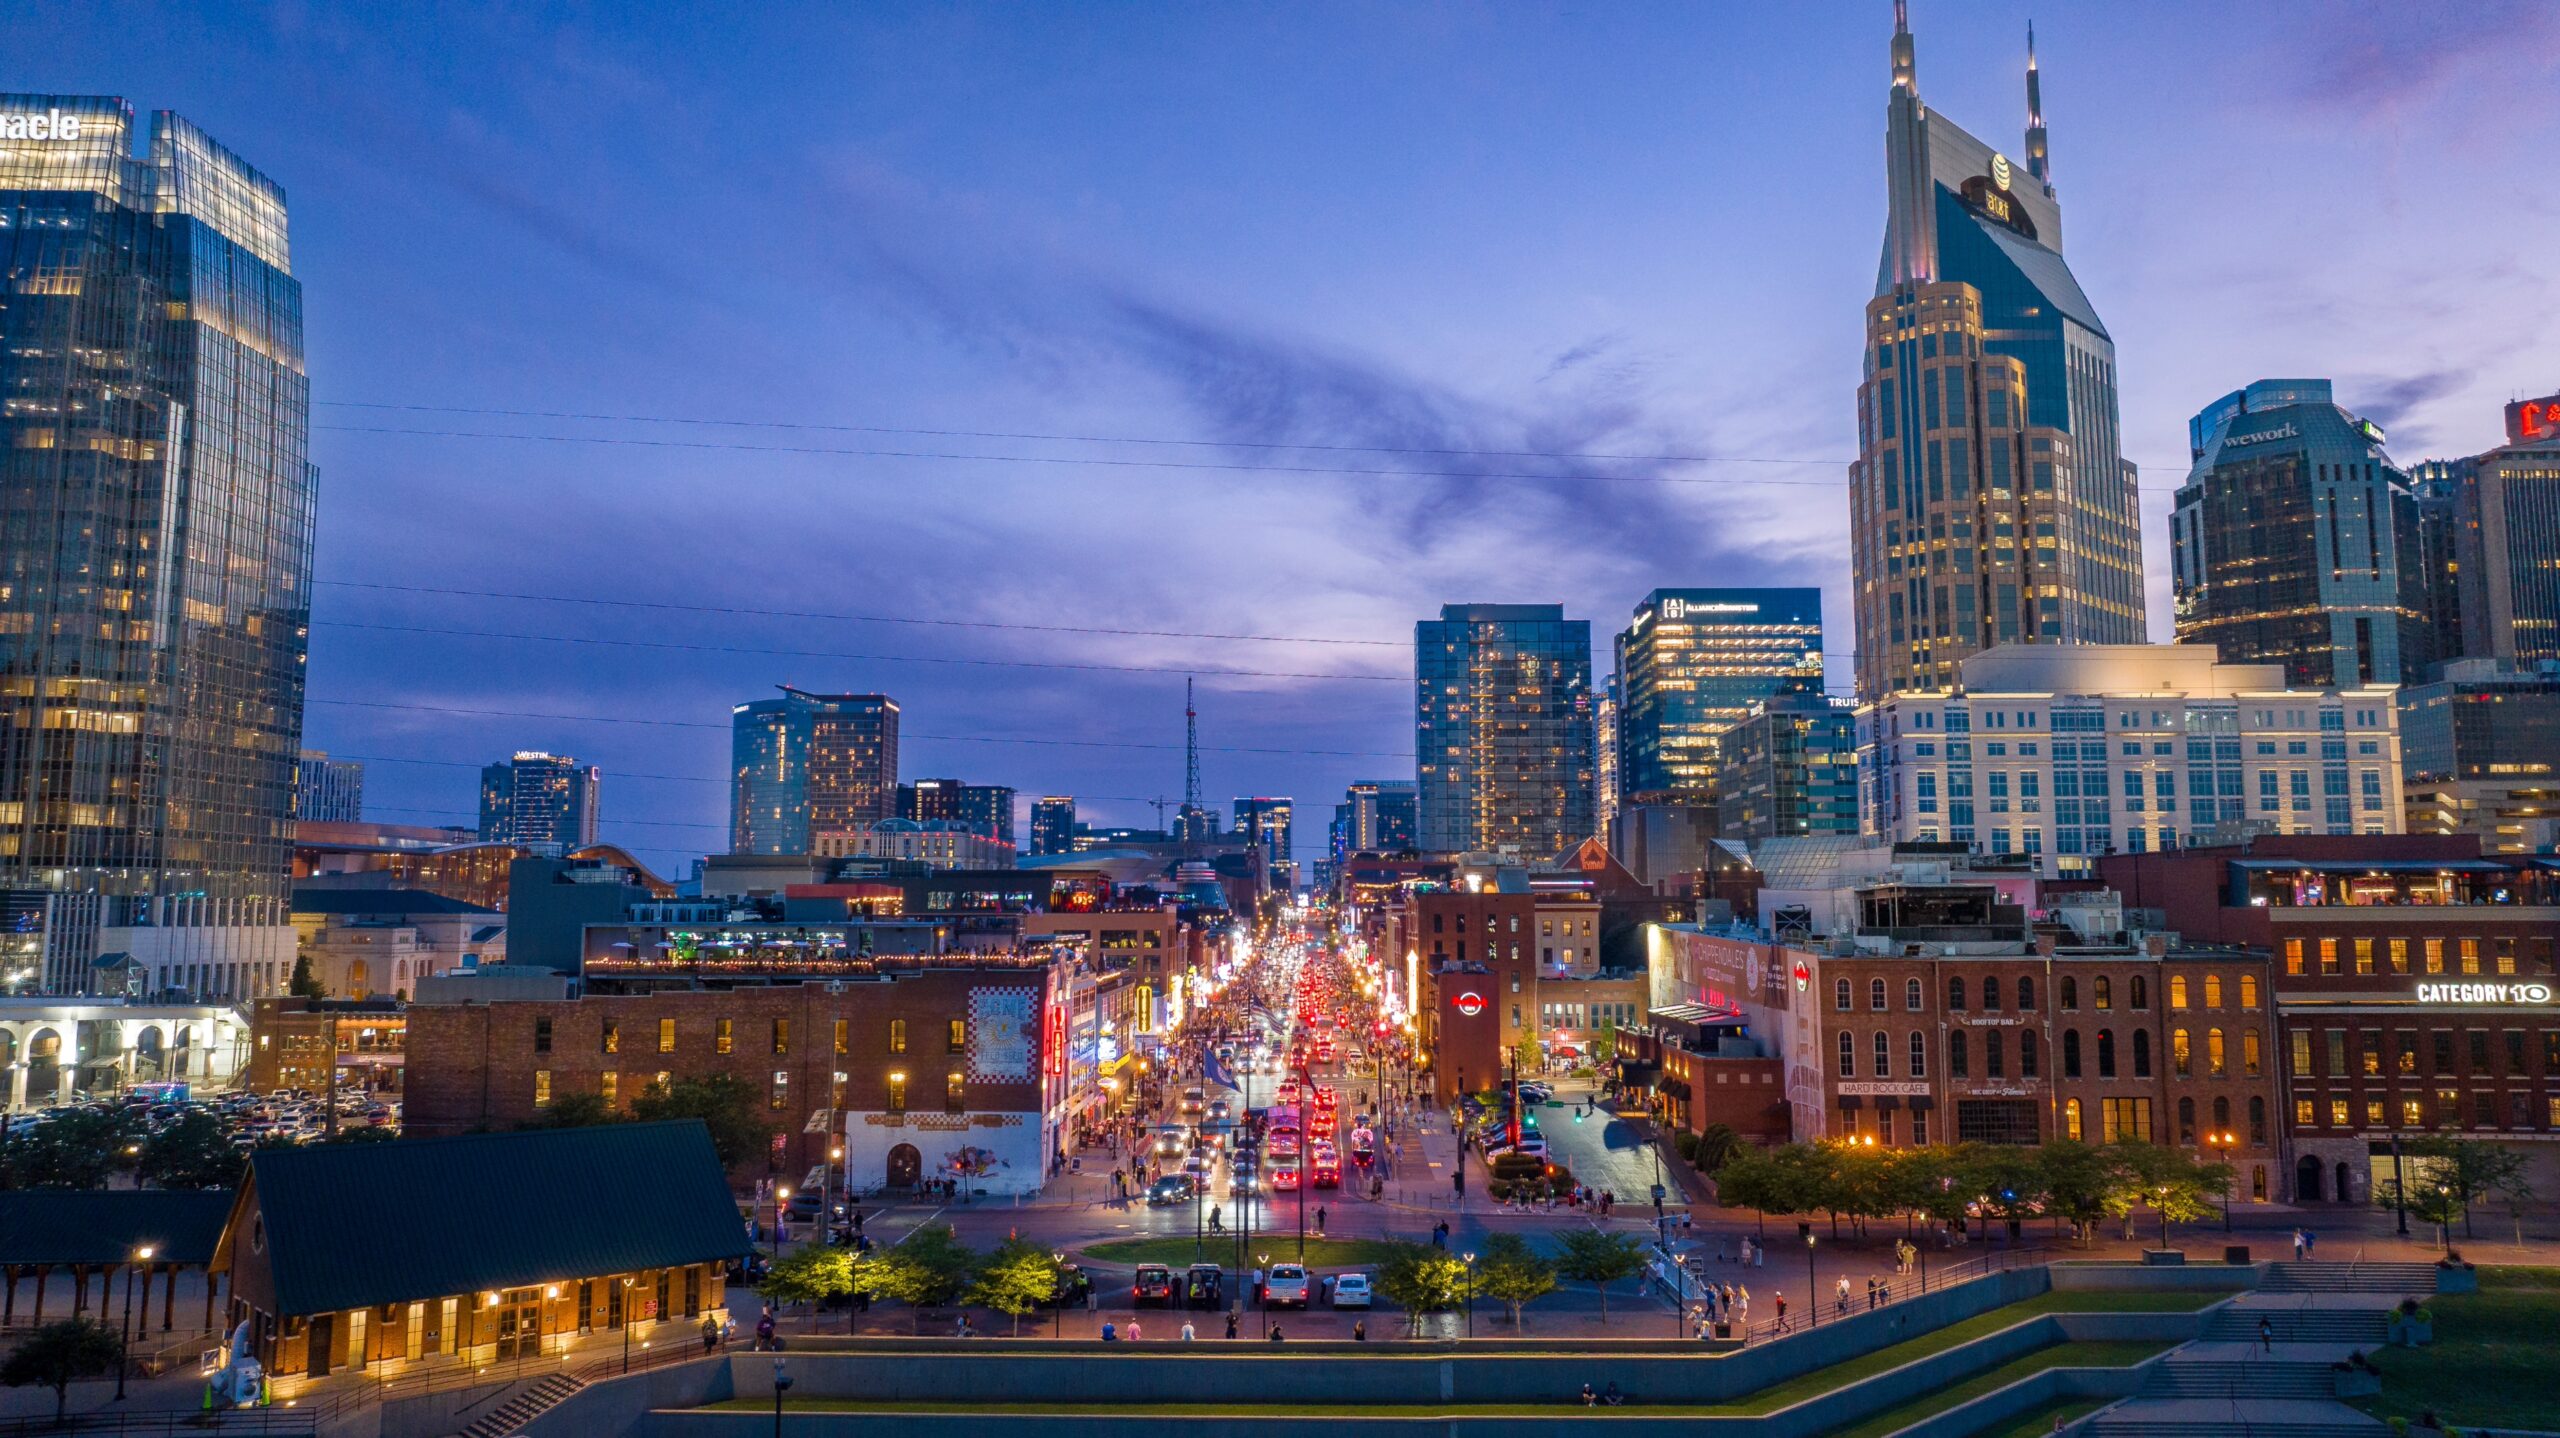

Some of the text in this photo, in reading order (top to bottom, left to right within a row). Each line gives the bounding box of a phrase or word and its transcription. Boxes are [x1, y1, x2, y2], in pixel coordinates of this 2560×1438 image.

[1987, 194, 2010, 222] at&t
[2224, 422, 2299, 448] wework
[515, 751, 548, 759] WESTIN
[2418, 984, 2550, 1003] CATEGORY 10
[1971, 1018, 2014, 1026] ROOFTOP BAR
[1844, 1083, 1926, 1093] HARD ROCK CAFE
